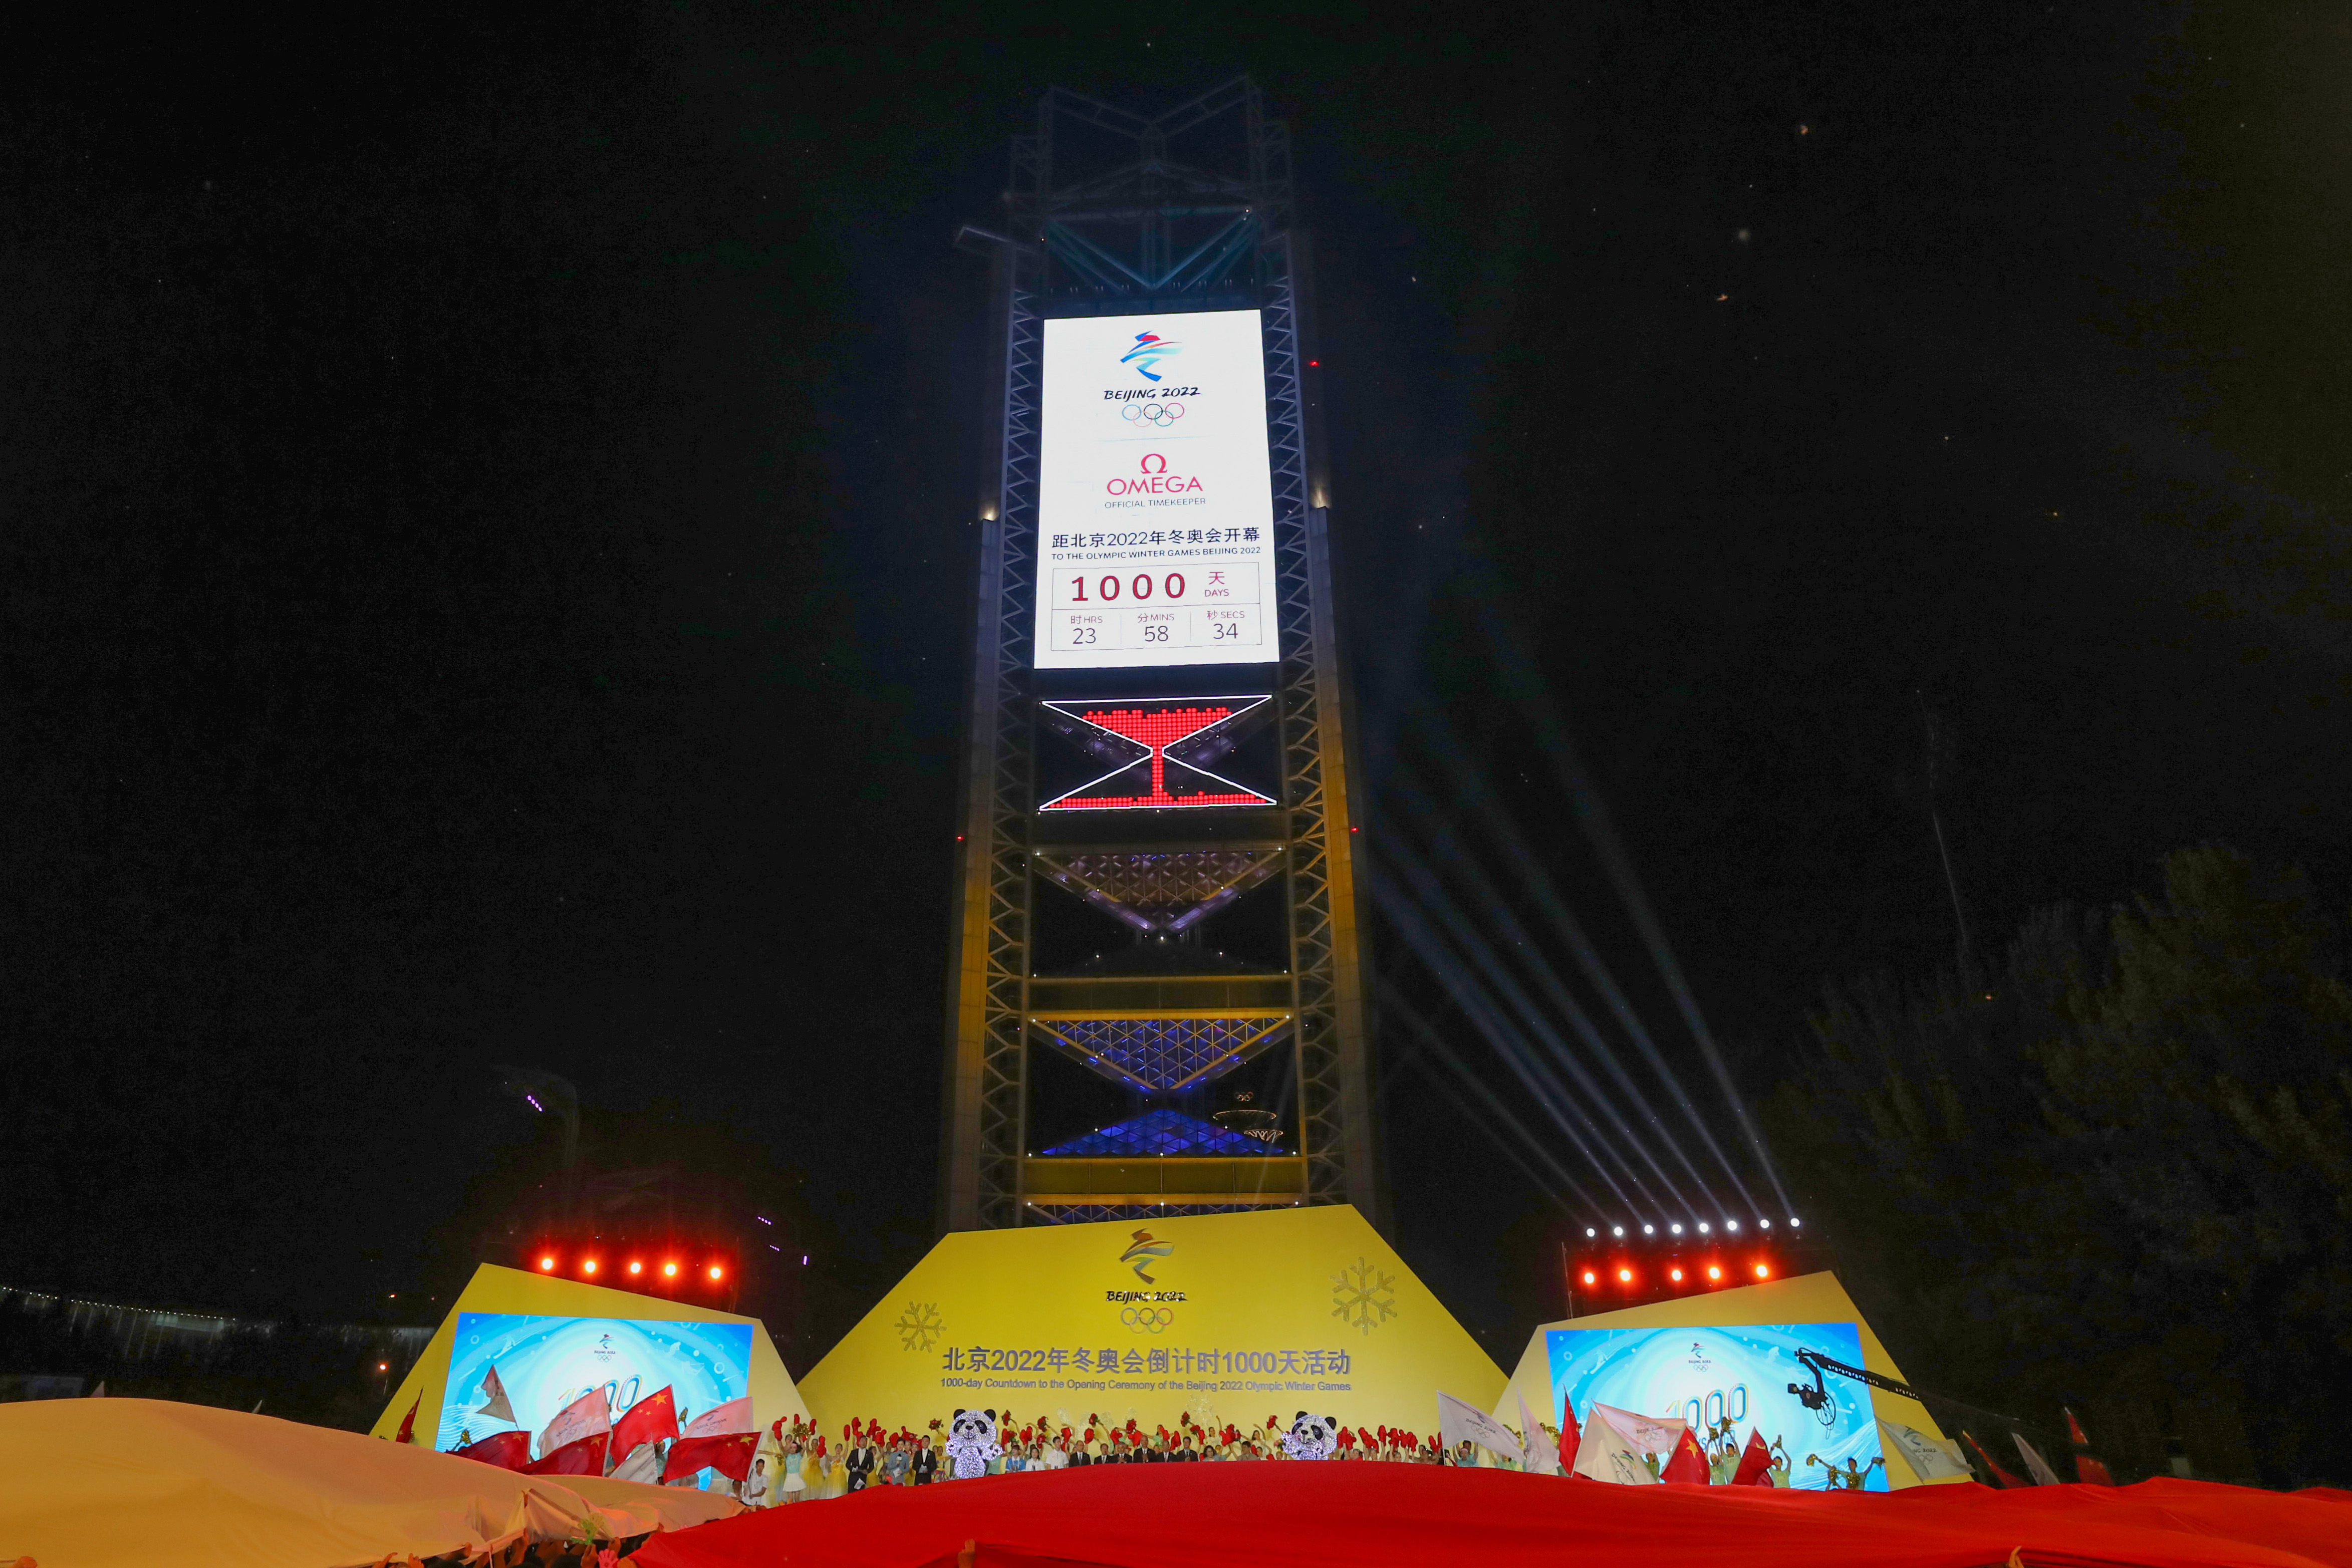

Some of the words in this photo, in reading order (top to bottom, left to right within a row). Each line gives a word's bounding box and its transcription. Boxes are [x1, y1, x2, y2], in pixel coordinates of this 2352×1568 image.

[1104, 389, 1156, 402] BEIJING
[1161, 387, 1203, 398] 2022
[1107, 475, 1203, 495] OMEGA
[1105, 500, 1145, 509] OFFICIAL
[1148, 497, 1206, 506] TIMEKEEPER
[1052, 527, 1260, 548] 距北京2022年冬奥会开幕
[1086, 552, 1127, 560] OLYMPIC
[1129, 550, 1165, 558] WINTER
[1167, 549, 1201, 557] GAMES
[1208, 571, 1225, 585] 天
[1072, 573, 1185, 602] 1000
[1204, 589, 1229, 598] DAYS
[1071, 615, 1082, 625] 时
[1084, 616, 1103, 624] HRS
[1137, 613, 1149, 623] 分
[1150, 613, 1175, 622] MINS
[1206, 610, 1218, 620] 秒
[1220, 611, 1245, 619] SECS
[1073, 628, 1097, 644] 23
[1144, 626, 1169, 642] 58
[1213, 623, 1238, 639] 34
[1106, 1291, 1150, 1304] BEIJING
[1153, 1291, 1188, 1301] 2022
[942, 1346, 1351, 1375] 北京2022年冬奥会倒计时1000天活动
[941, 1378, 983, 1388] 1000-day
[985, 1378, 1036, 1388] Countdown
[1039, 1380, 1048, 1388] to
[1051, 1380, 1065, 1388] the
[1068, 1380, 1106, 1391] Opening
[1108, 1380, 1155, 1391] Ceremony
[1158, 1381, 1167, 1389] of
[1169, 1381, 1183, 1389] the
[1186, 1381, 1217, 1392] Beijing
[1220, 1382, 1243, 1390] 2022
[1245, 1381, 1283, 1392] Olympic
[1285, 1381, 1316, 1391] Winter
[1318, 1382, 1352, 1391] Games
